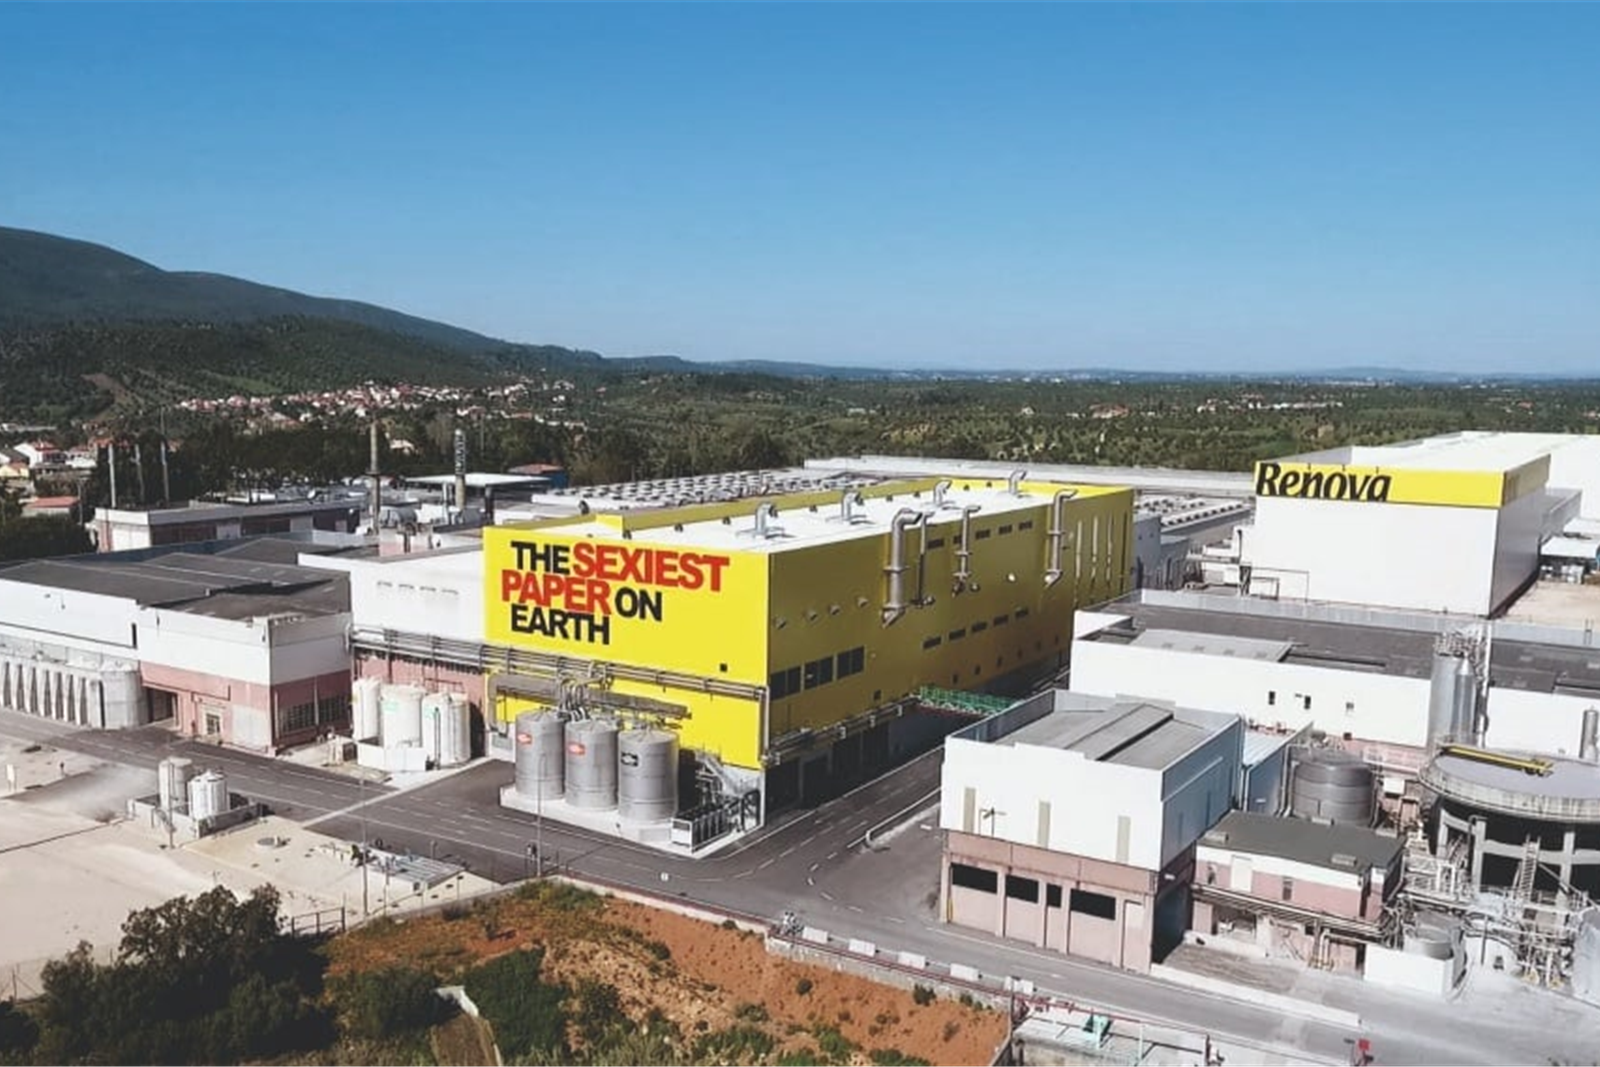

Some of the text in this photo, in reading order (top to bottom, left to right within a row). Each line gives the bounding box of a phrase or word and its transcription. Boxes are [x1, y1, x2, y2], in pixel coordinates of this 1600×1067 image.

[1256, 462, 1392, 502] Renova
[510, 540, 730, 592] THE SEXIEST
[501, 569, 663, 622] PAPER ON
[511, 603, 610, 645] EARTH
